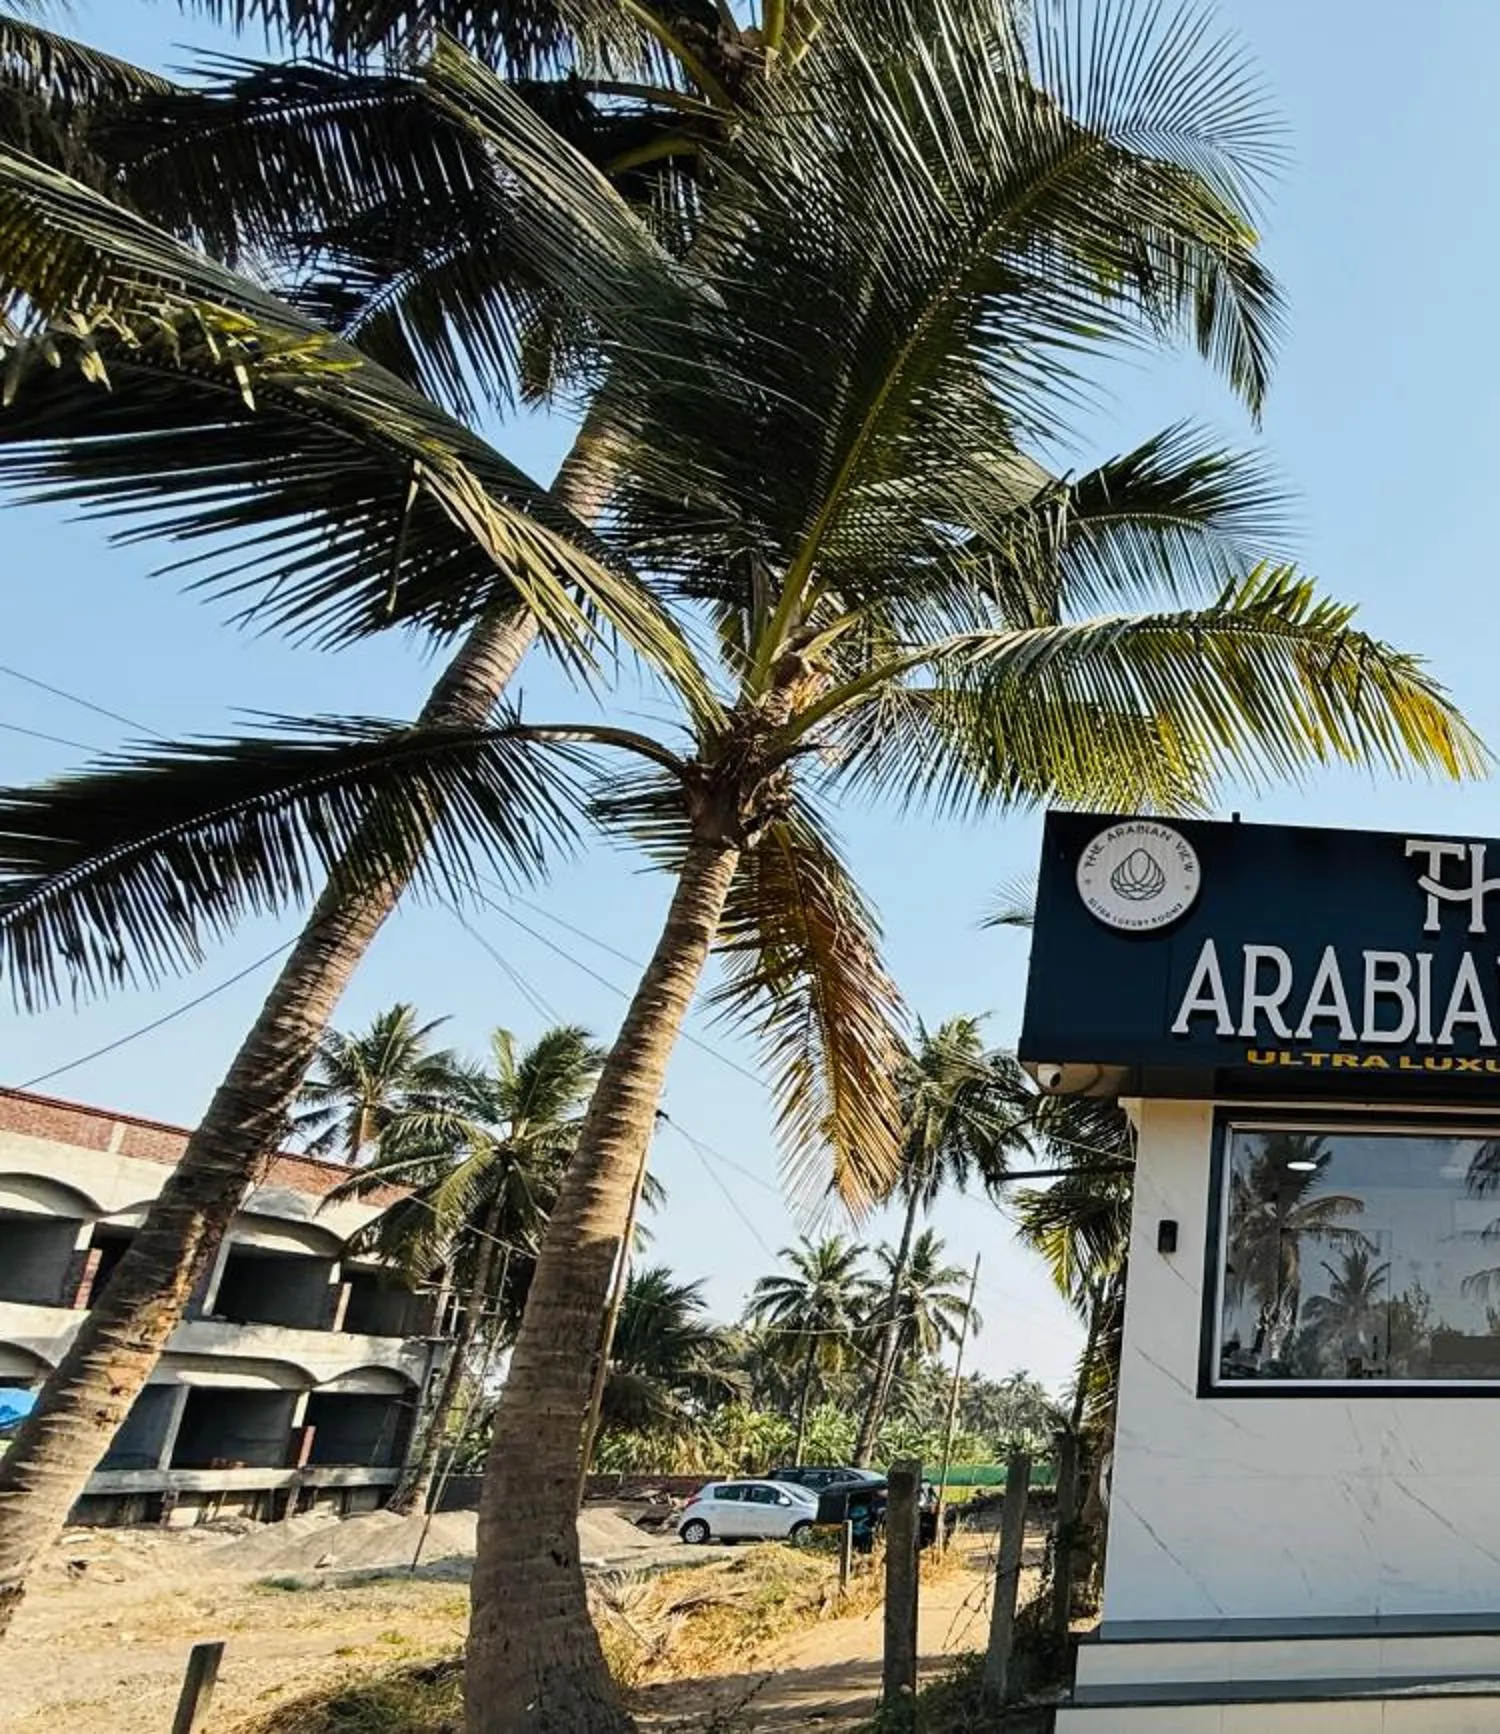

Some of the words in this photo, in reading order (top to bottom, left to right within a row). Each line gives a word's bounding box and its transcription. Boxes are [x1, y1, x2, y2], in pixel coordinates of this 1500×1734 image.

[1085, 843, 1106, 869] THE
[1107, 824, 1173, 842] ARABIAN
[1175, 841, 1195, 873] VIEW
[1247, 1049, 1391, 1069] ULTRA
